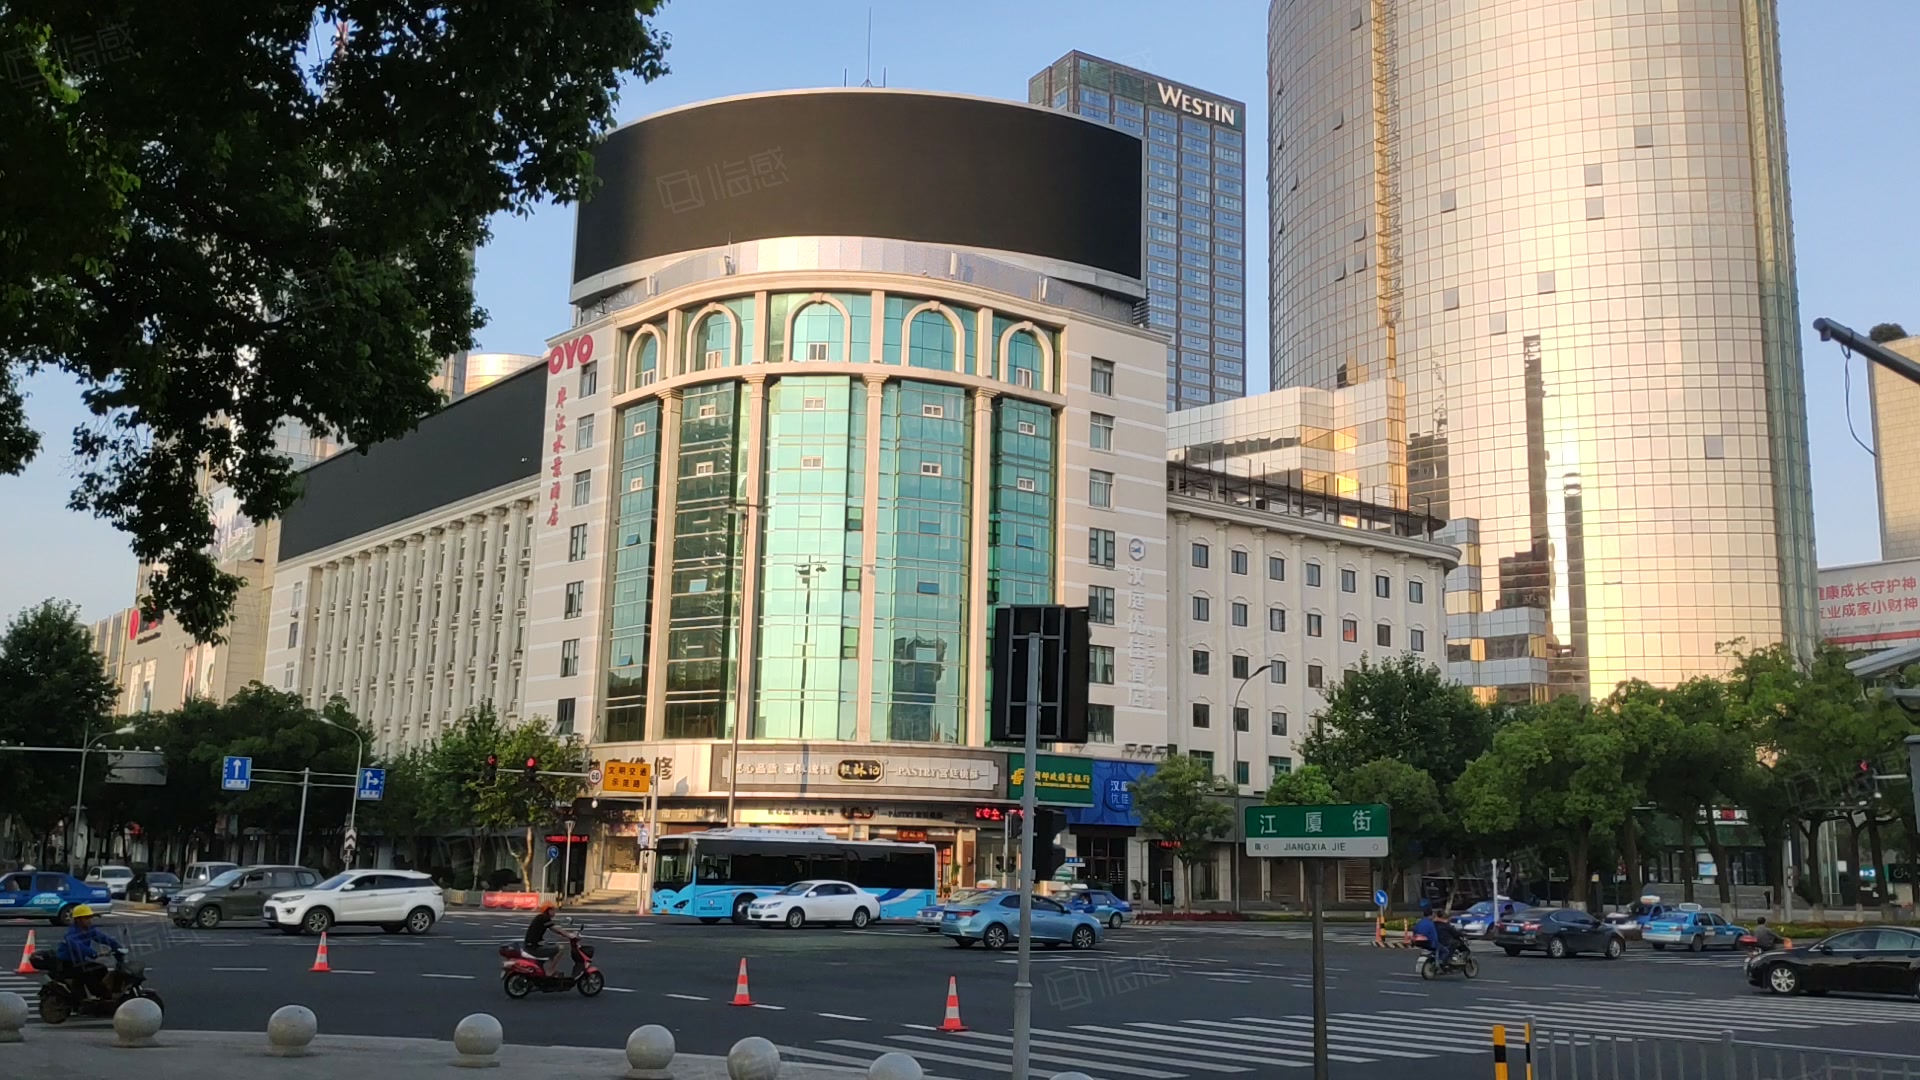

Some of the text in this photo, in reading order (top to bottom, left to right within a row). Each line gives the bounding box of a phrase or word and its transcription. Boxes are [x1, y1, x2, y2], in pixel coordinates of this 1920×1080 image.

[1157, 82, 1235, 126] WESTIN
[548, 334, 594, 375] OYO
[1128, 565, 1145, 707] 汉庭优佳酒店
[591, 770, 600, 780] 60
[608, 766, 647, 777] 文明交通
[1034, 770, 1091, 784] 国邮政储蓄银行
[1259, 809, 1372, 834] 江厦街
[1284, 842, 1327, 851] JIANGXIA
[1332, 842, 1347, 851] JIE
